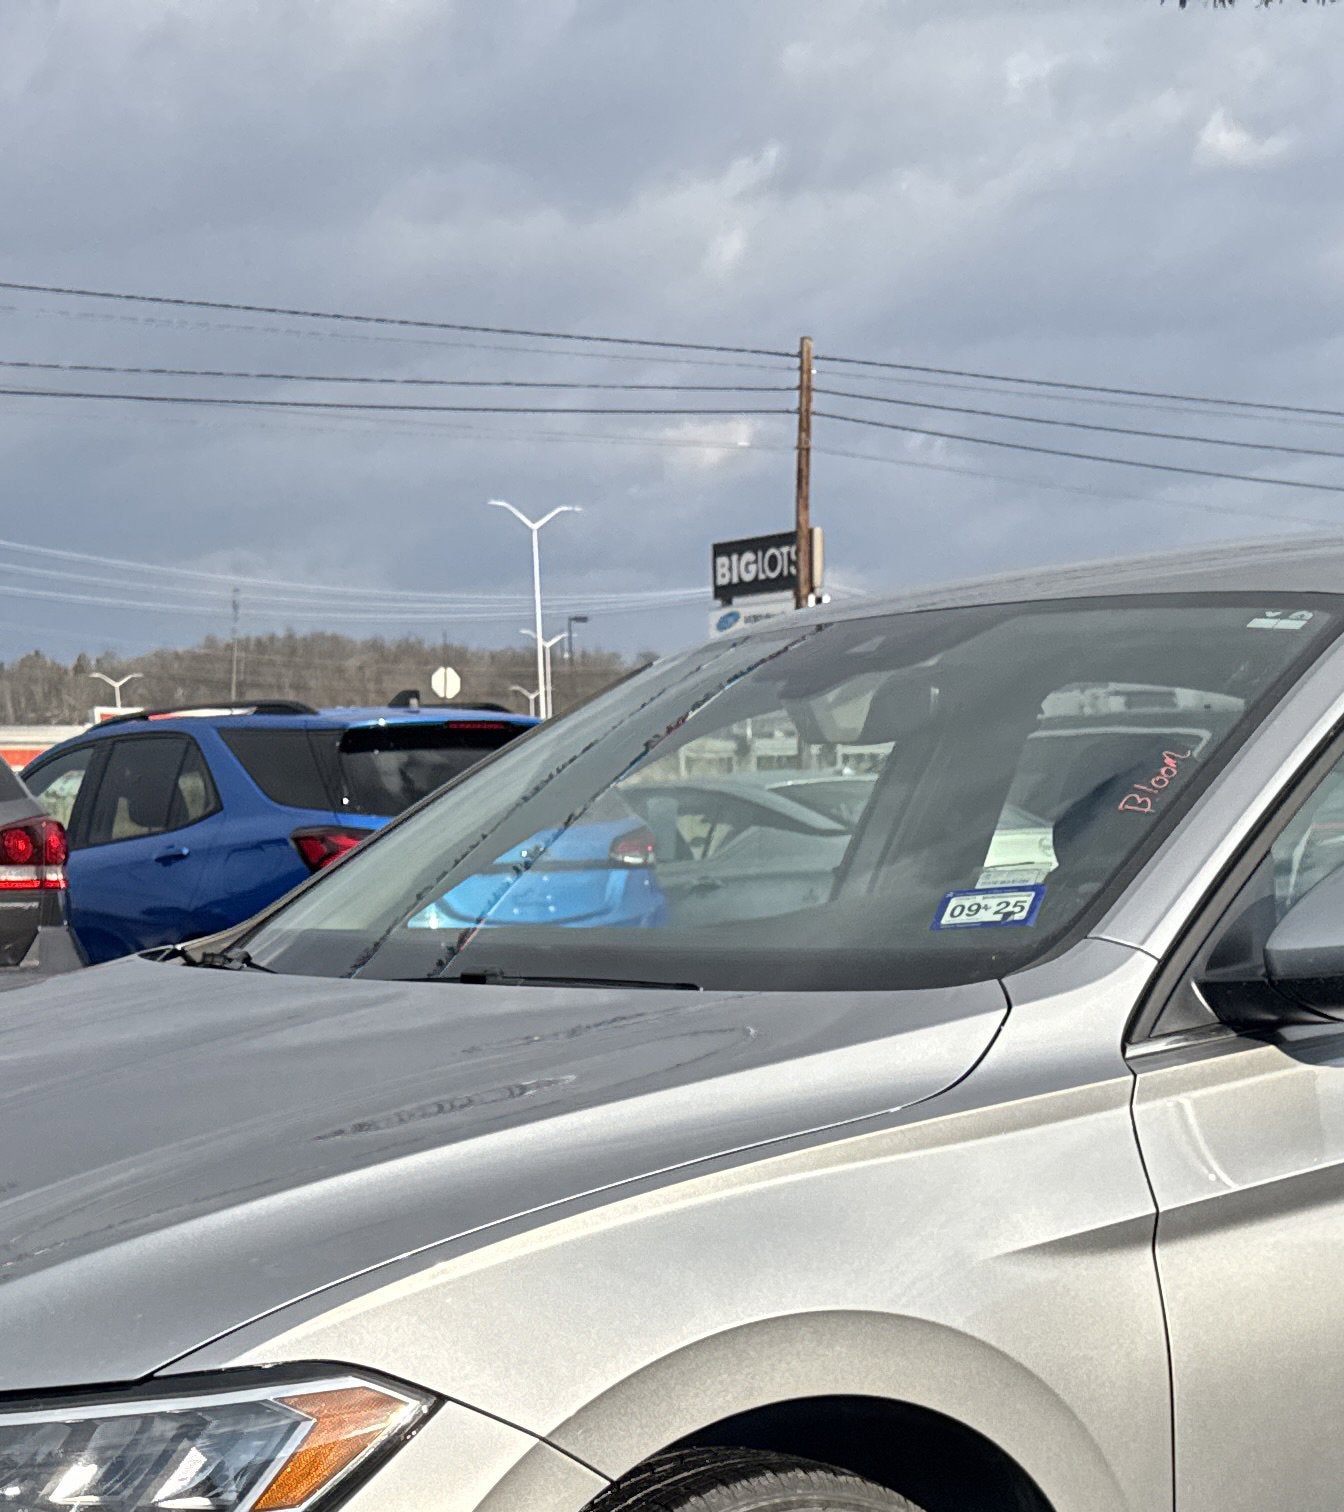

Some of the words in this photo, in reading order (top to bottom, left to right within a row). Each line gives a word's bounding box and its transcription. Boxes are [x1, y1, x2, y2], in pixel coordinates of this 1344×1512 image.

[1118, 750, 1191, 813] Bloom
[949, 902, 982, 919] 09
[992, 900, 1028, 916] 25
